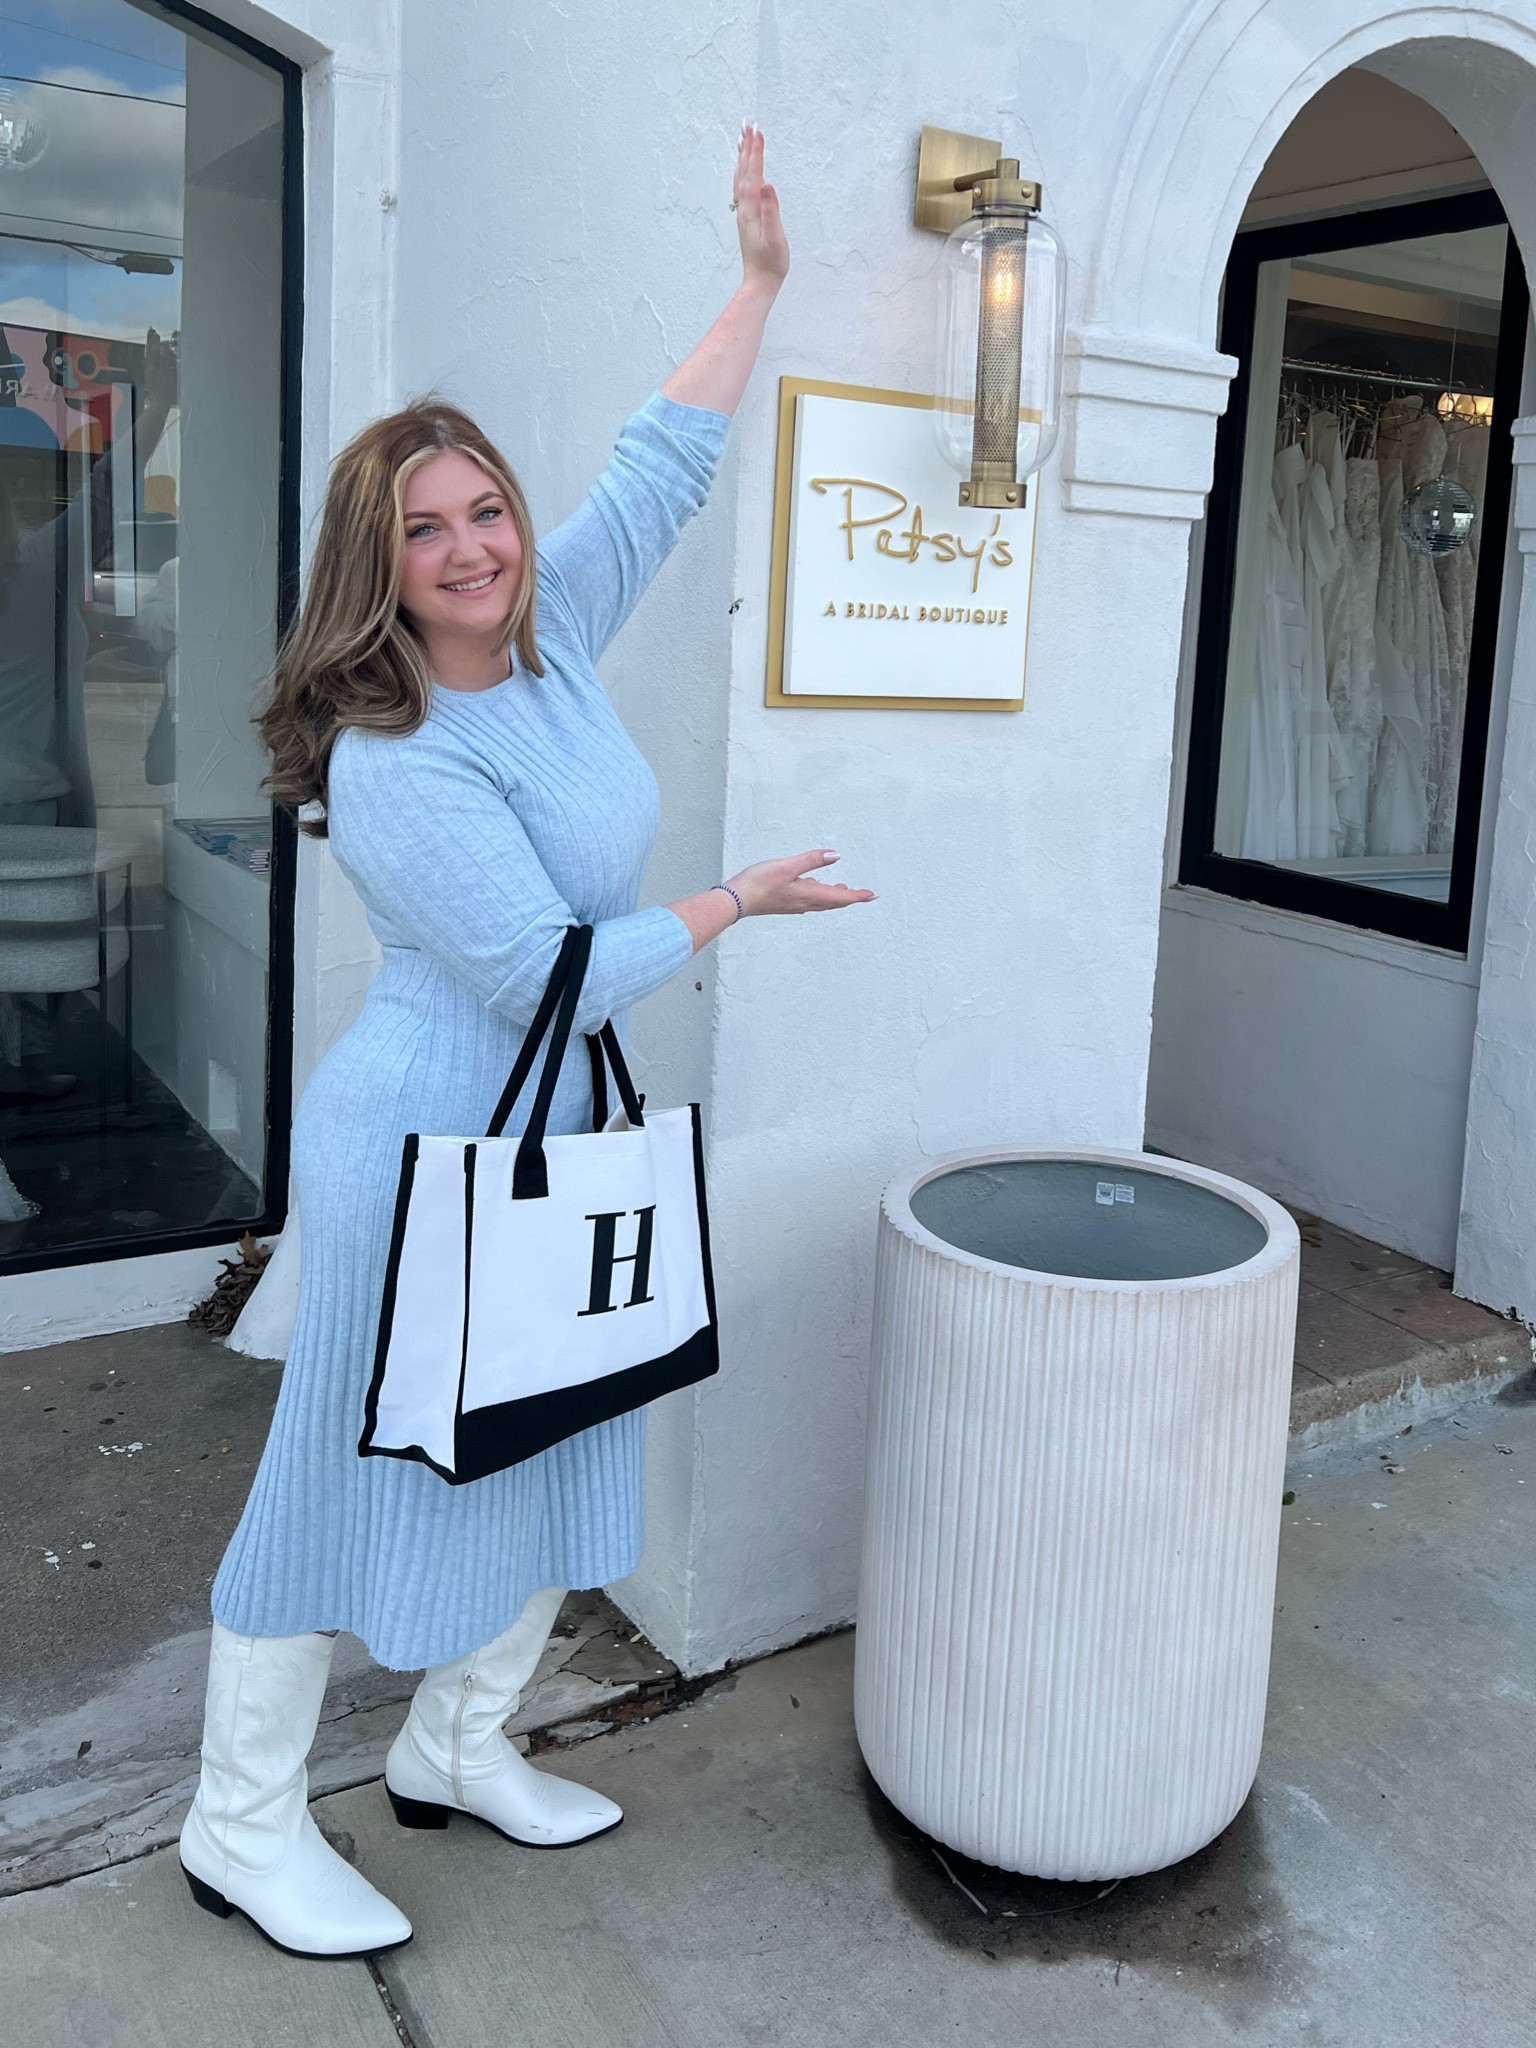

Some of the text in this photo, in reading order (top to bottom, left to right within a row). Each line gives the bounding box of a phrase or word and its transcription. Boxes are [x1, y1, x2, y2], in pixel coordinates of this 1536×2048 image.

[811, 478, 1013, 593] Patsy's
[824, 601, 1008, 624] A BRIDAL BOUTIQUE
[577, 1204, 657, 1316] H
